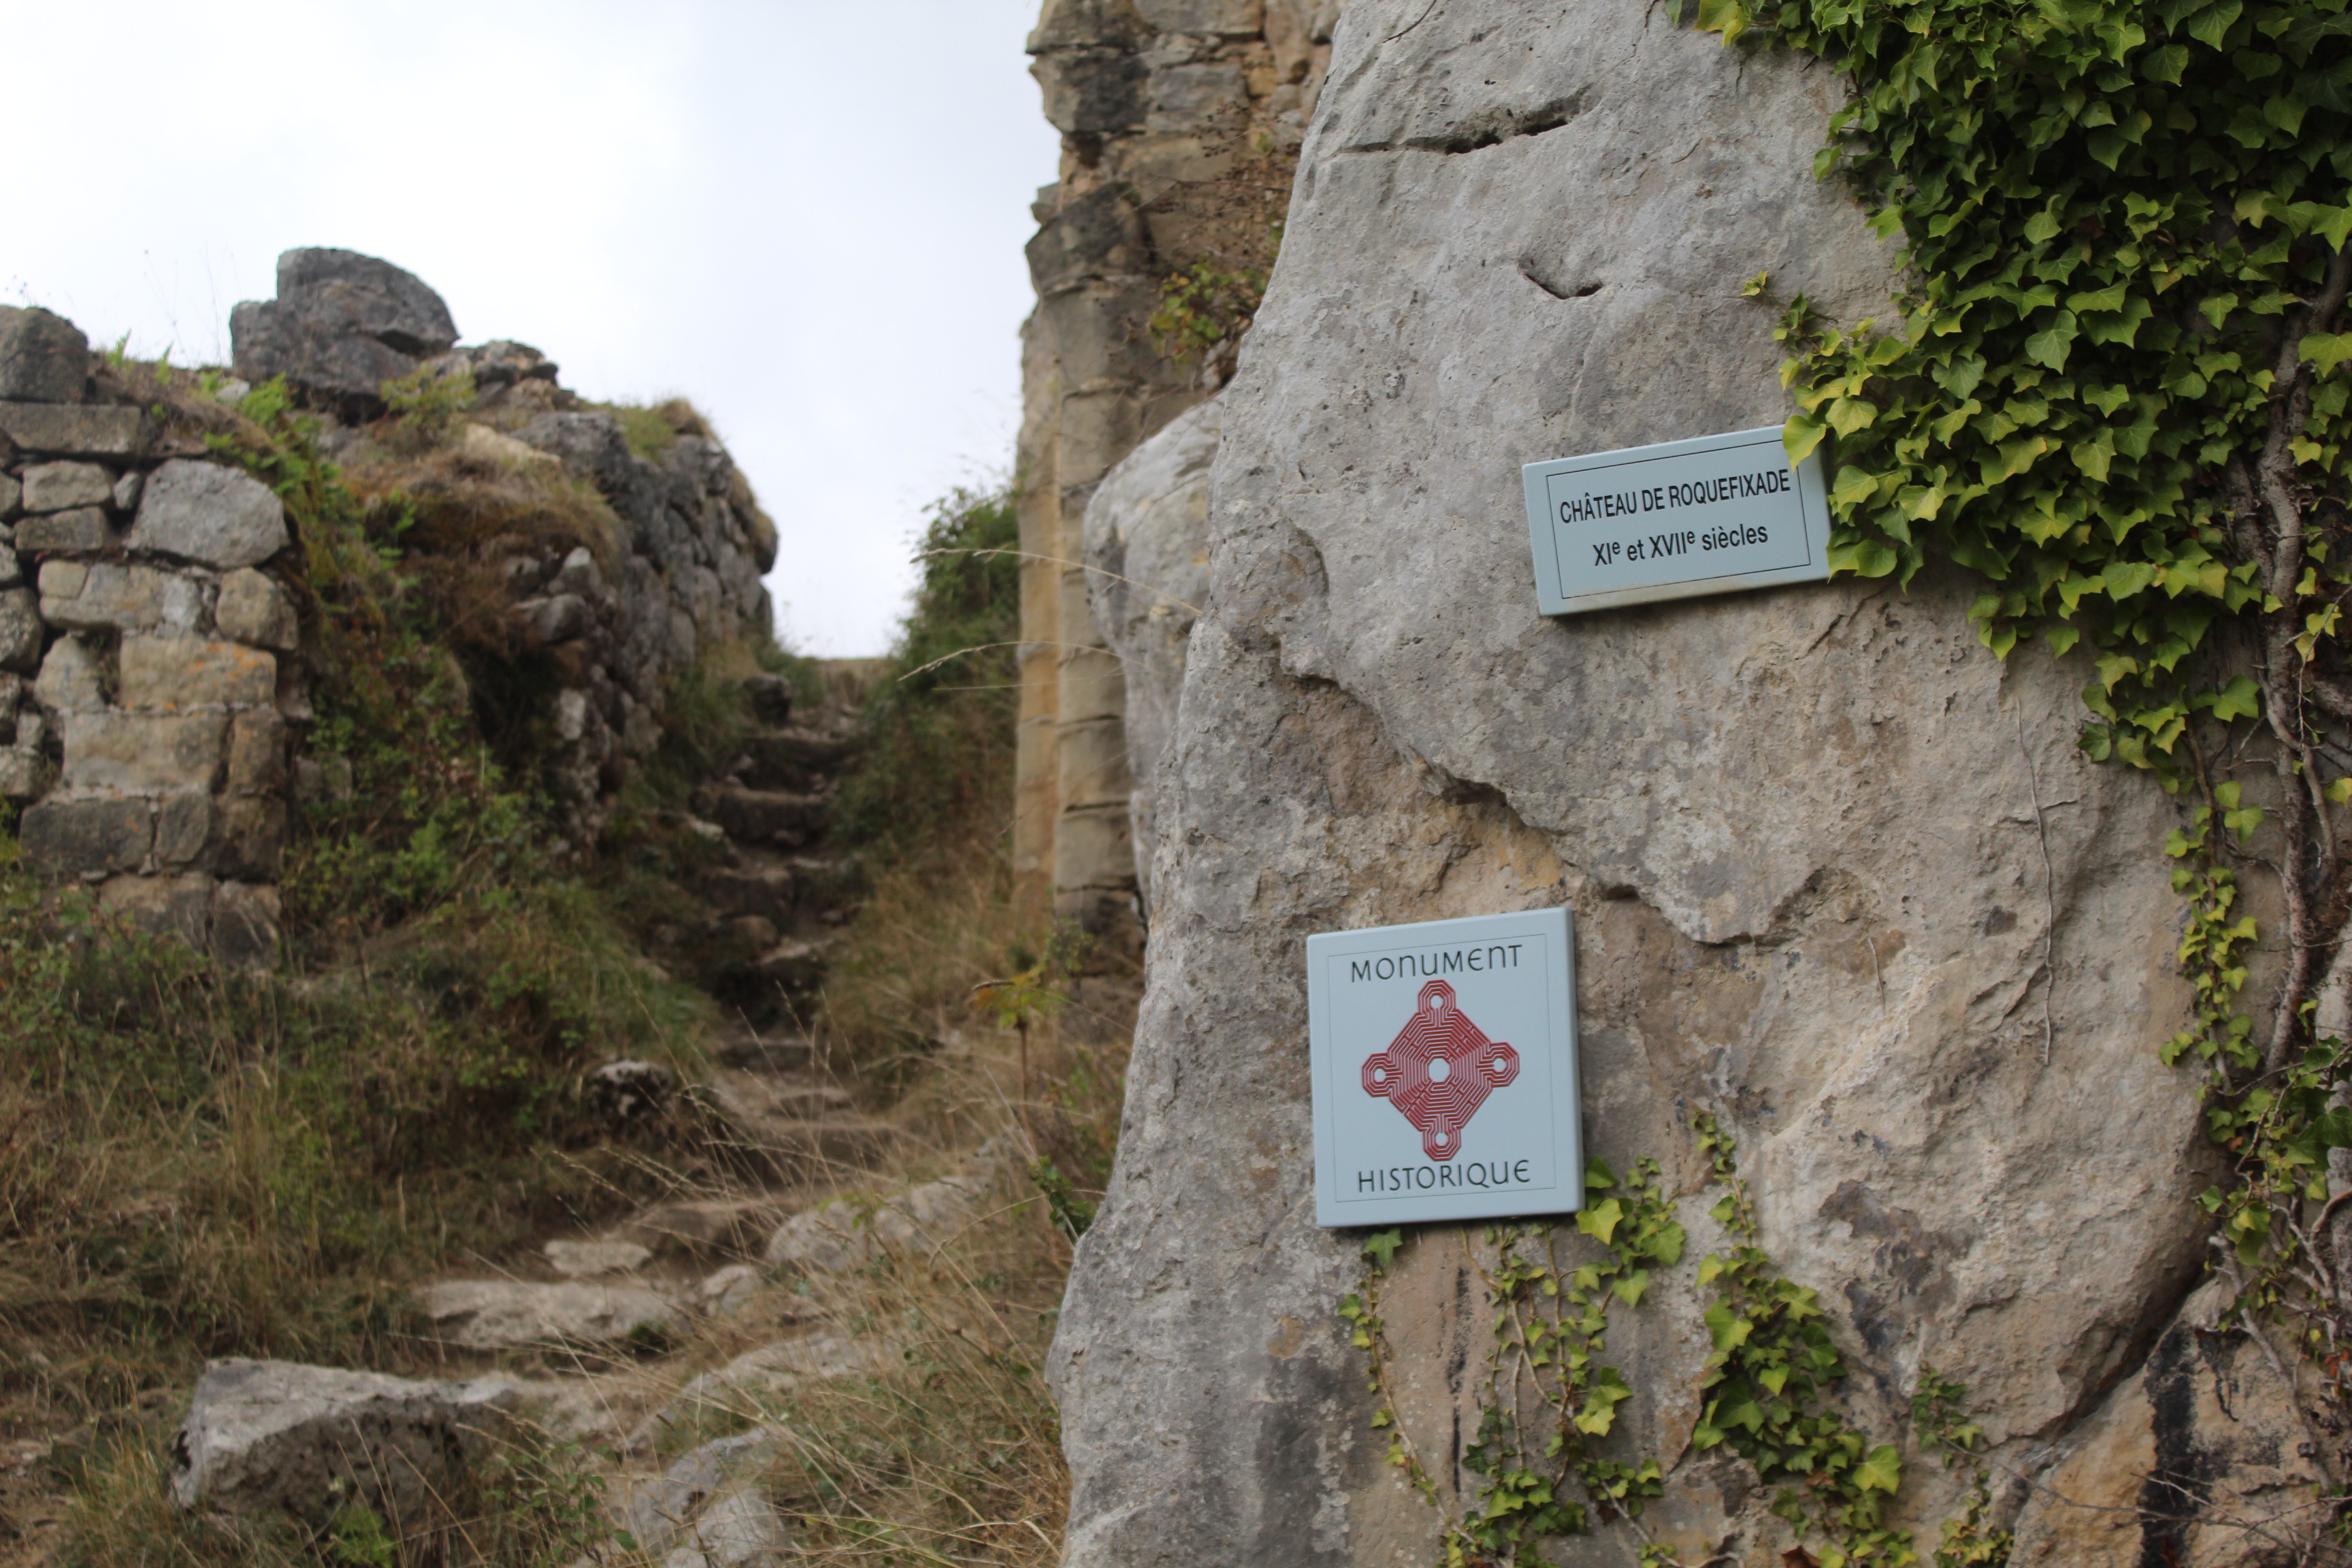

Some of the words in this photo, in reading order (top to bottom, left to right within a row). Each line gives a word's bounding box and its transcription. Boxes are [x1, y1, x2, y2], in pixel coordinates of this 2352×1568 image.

[1560, 491, 1637, 523] CHÂTEAU
[1642, 487, 1665, 512] DE
[1669, 468, 1791, 508] ROQUEFIXADE
[1592, 540, 1621, 566] XIe
[1627, 539, 1646, 561] et
[1649, 530, 1696, 559] XVIIe
[1702, 523, 1769, 551] siècles
[1351, 944, 1523, 983] MONUMENT
[1358, 1159, 1531, 1193] HISTORIQUE
